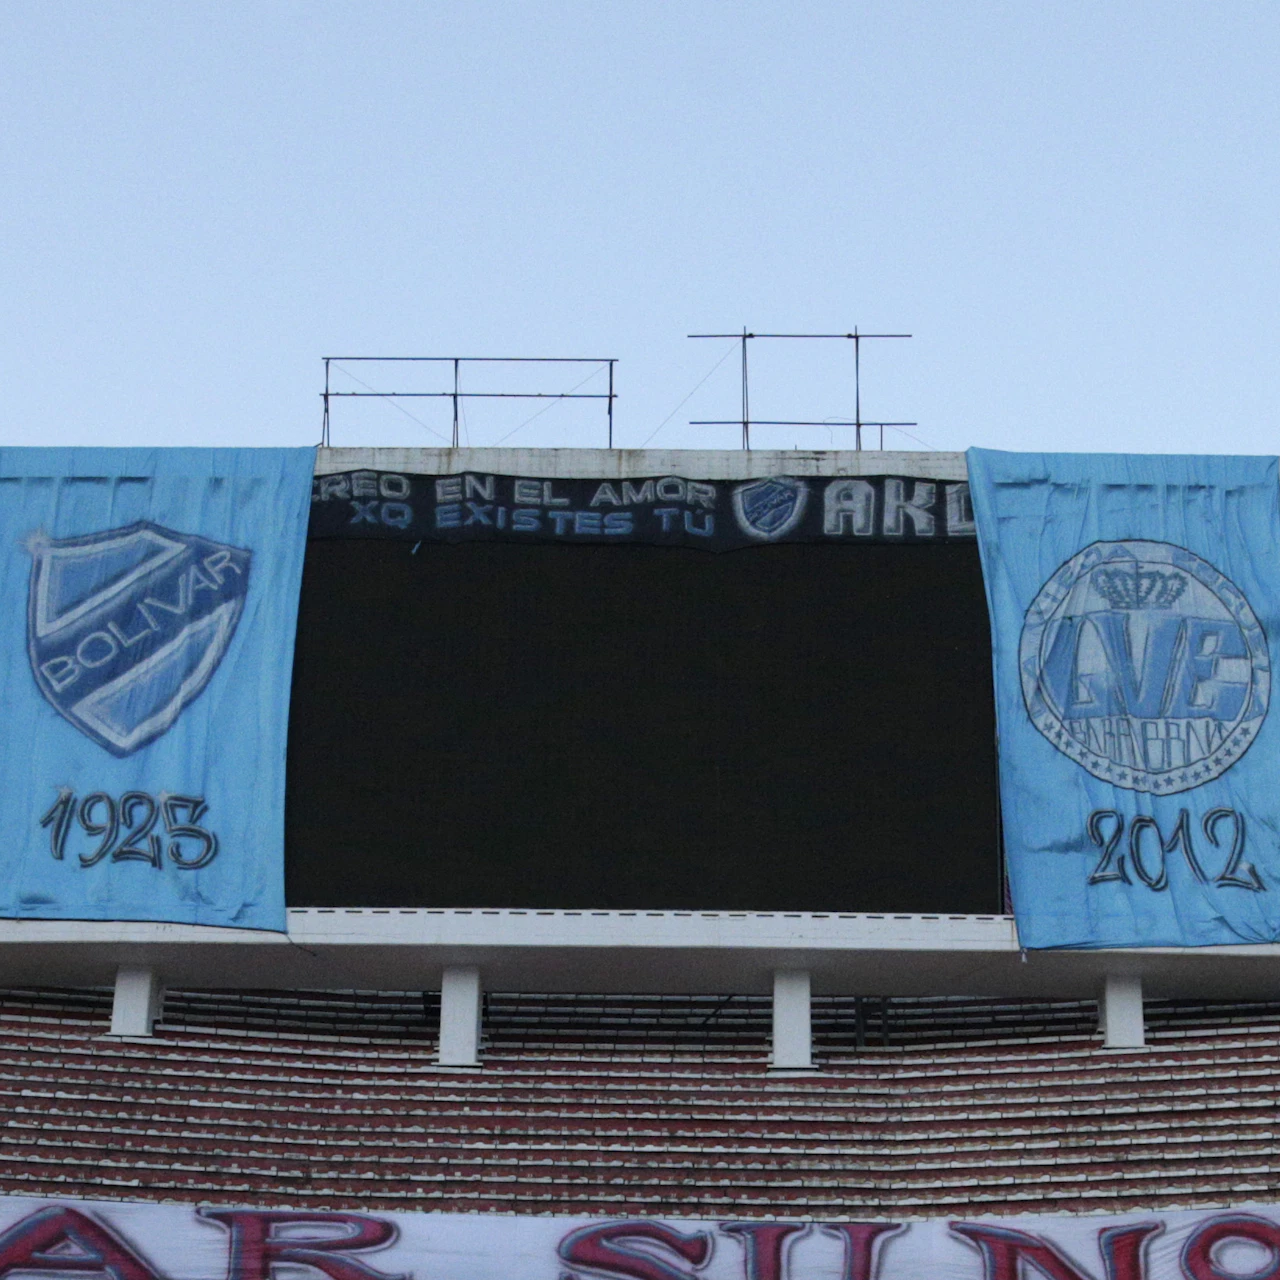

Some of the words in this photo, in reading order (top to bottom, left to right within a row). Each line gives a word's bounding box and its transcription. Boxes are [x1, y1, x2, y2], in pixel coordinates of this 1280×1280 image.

[349, 500, 414, 529] XQ
[434, 502, 634, 536] EXISTES
[435, 474, 495, 502] EN
[514, 477, 569, 507] EL
[590, 476, 716, 509] AMOR
[41, 550, 242, 695] BOLIVAR
[40, 790, 220, 870] 1925
[1086, 806, 1266, 891] 2012
